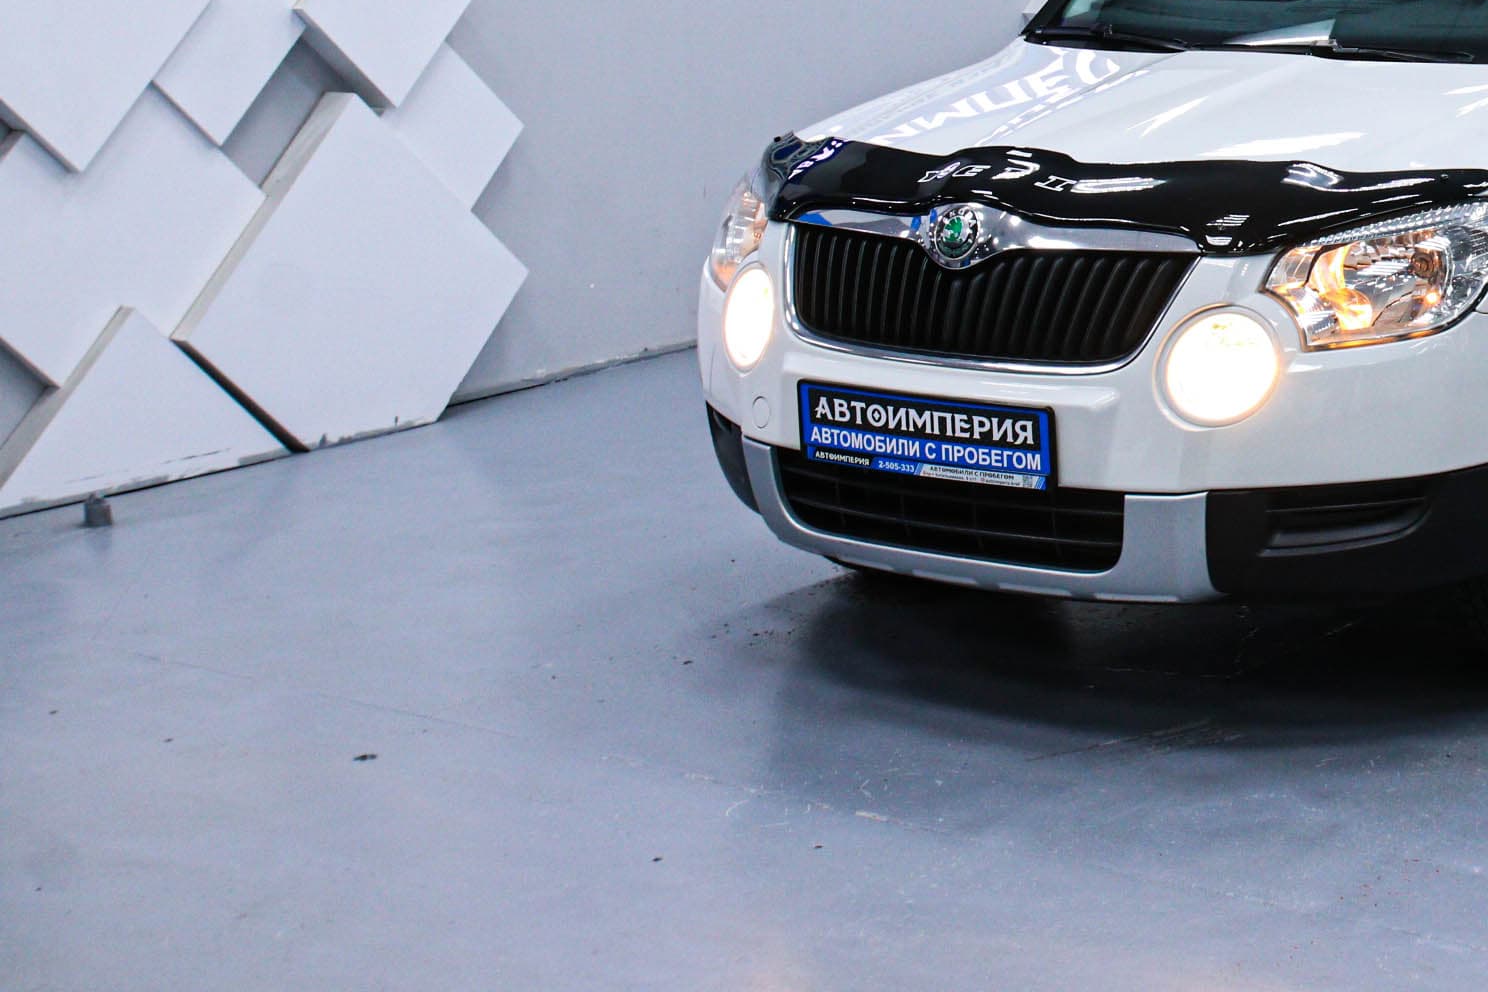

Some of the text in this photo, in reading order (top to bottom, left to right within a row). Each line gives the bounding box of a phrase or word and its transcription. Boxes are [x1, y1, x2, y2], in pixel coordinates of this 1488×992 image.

[814, 396, 1035, 445] АВТОИМПЕРИЯ
[811, 426, 1041, 471] АВТОМОБИЛИ С ПРОБЕГОМ
[815, 450, 870, 466] АВТОИМПЕРИЯ
